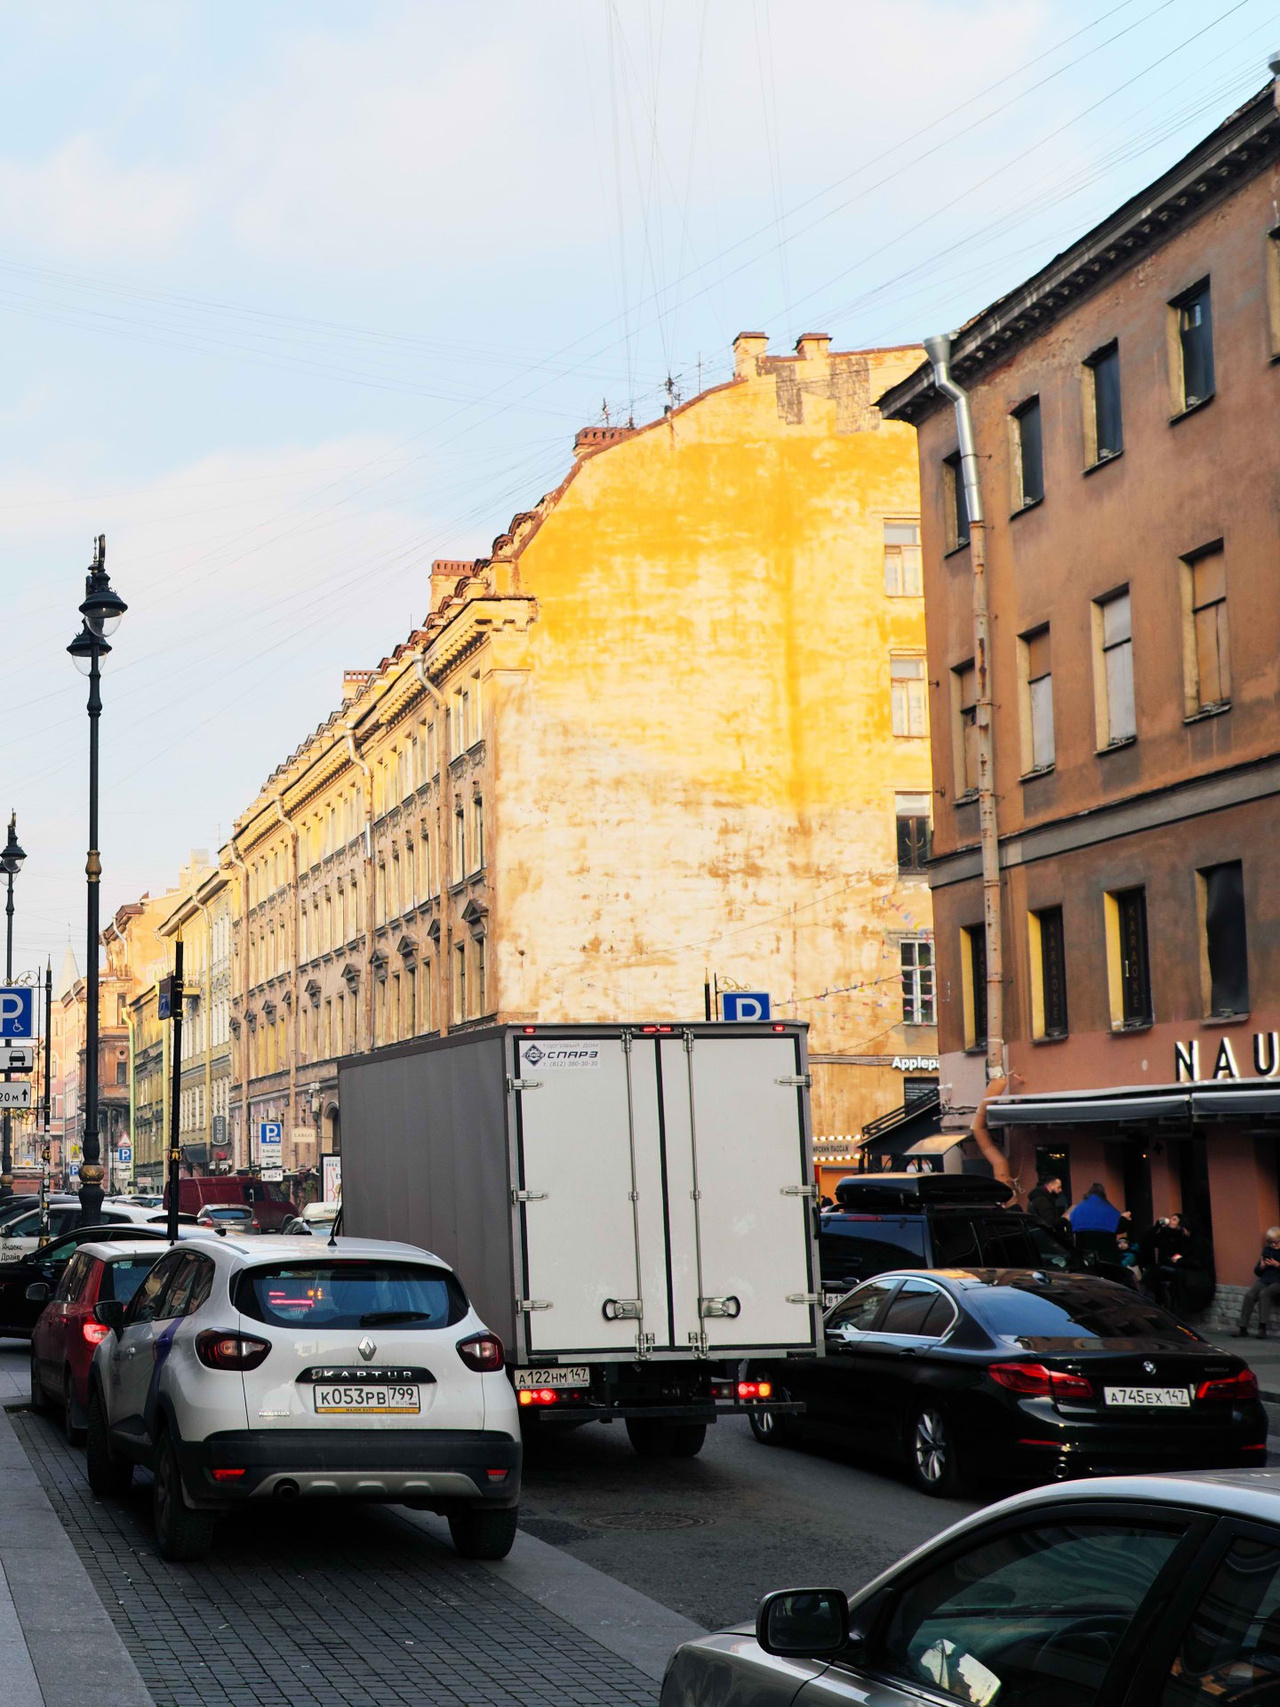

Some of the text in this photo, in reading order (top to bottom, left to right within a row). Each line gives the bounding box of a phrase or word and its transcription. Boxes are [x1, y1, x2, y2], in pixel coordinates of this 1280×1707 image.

[1174, 1031, 1280, 1083] NAU
[265, 1125, 278, 1142] P
[1, 1243, 23, 1251] Яндекс
[1, 1253, 21, 1261] Драйв
[323, 1370, 412, 1379] KAPTUR
[569, 1368, 587, 1379] 147
[389, 1387, 415, 1401] 799
[1166, 1390, 1184, 1401] 147
